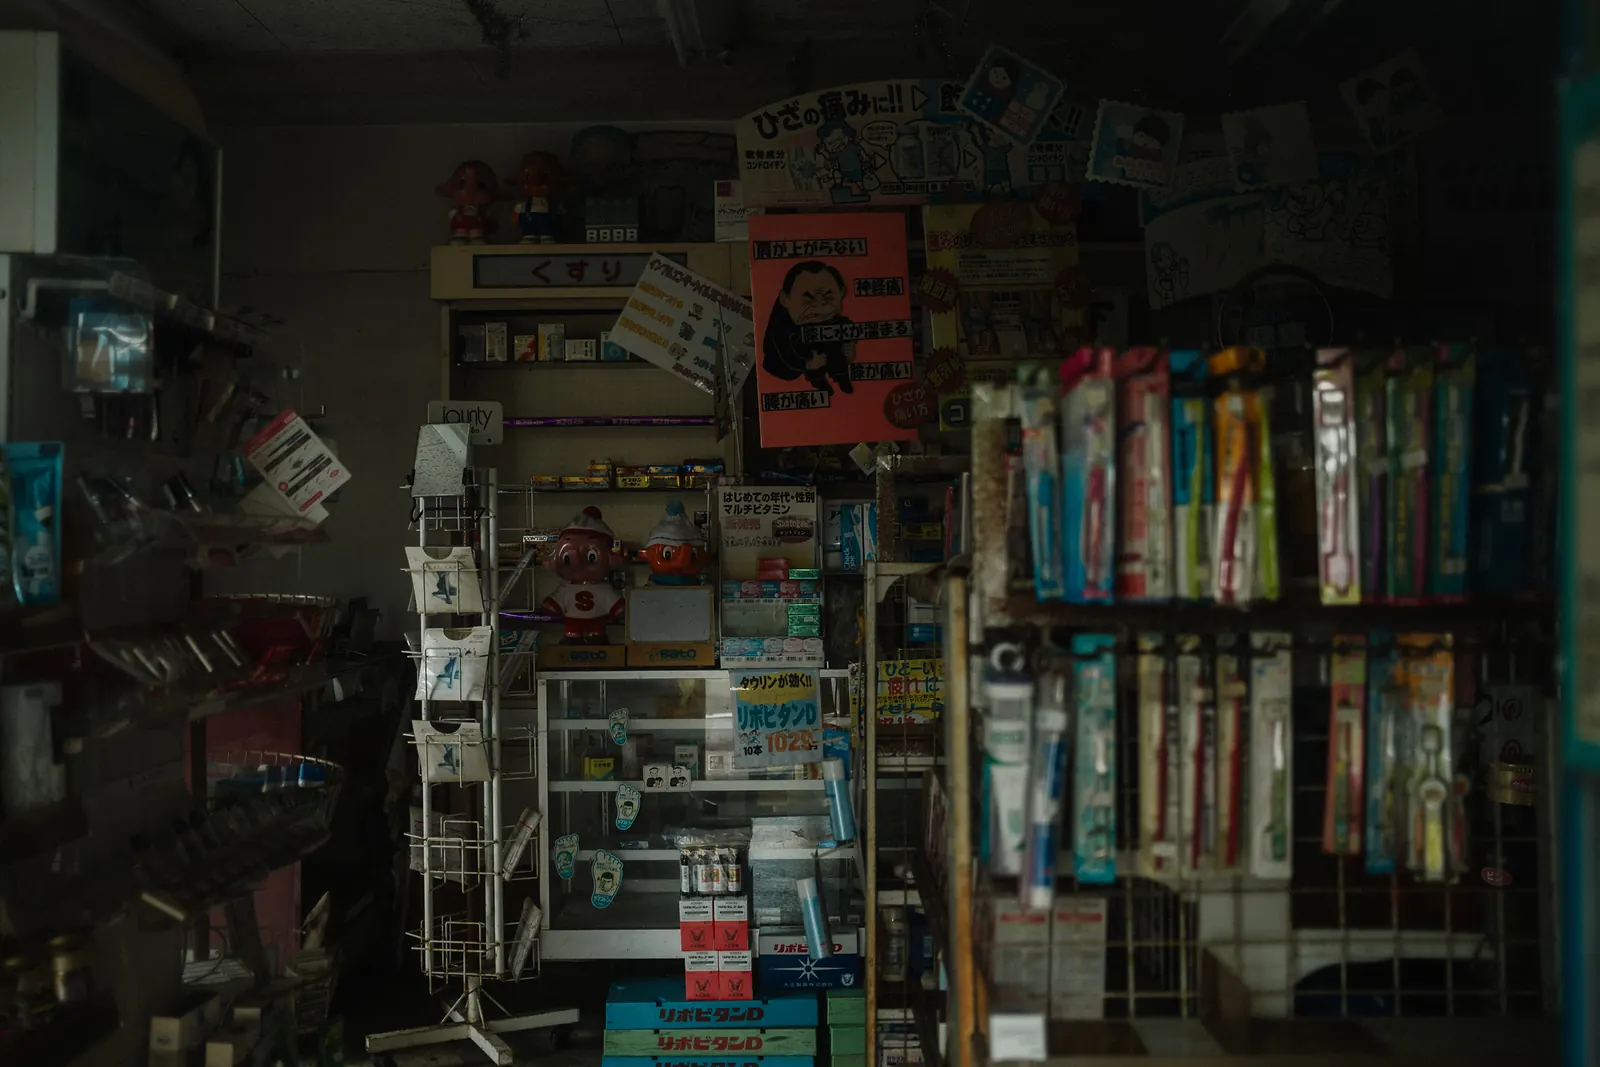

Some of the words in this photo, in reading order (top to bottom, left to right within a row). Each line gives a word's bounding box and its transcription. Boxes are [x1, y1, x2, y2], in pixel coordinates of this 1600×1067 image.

[752, 84, 903, 139] ひざの痛みに!!
[746, 161, 786, 169] コンドロイチン
[757, 240, 864, 258] 肩が上がらない
[532, 259, 622, 283] くすり
[804, 322, 909, 341] 膝に水が溜まる
[850, 363, 909, 380] 膝が痛い
[764, 392, 825, 411] 腰が痛い
[891, 387, 927, 405] ひざが
[442, 406, 493, 430] jaunty
[723, 491, 815, 503] はじめての年代・性別
[723, 504, 791, 515] マルチビタミン
[575, 590, 595, 611] S
[885, 661, 935, 676] ひどーい
[740, 672, 813, 690] タウリンが効く!!
[737, 703, 817, 731] リポビタンD
[743, 745, 763, 756] 10本
[773, 943, 843, 954] リポビD
[658, 1007, 764, 1023] リポビタンD
[657, 1035, 763, 1051] リポビタンD
